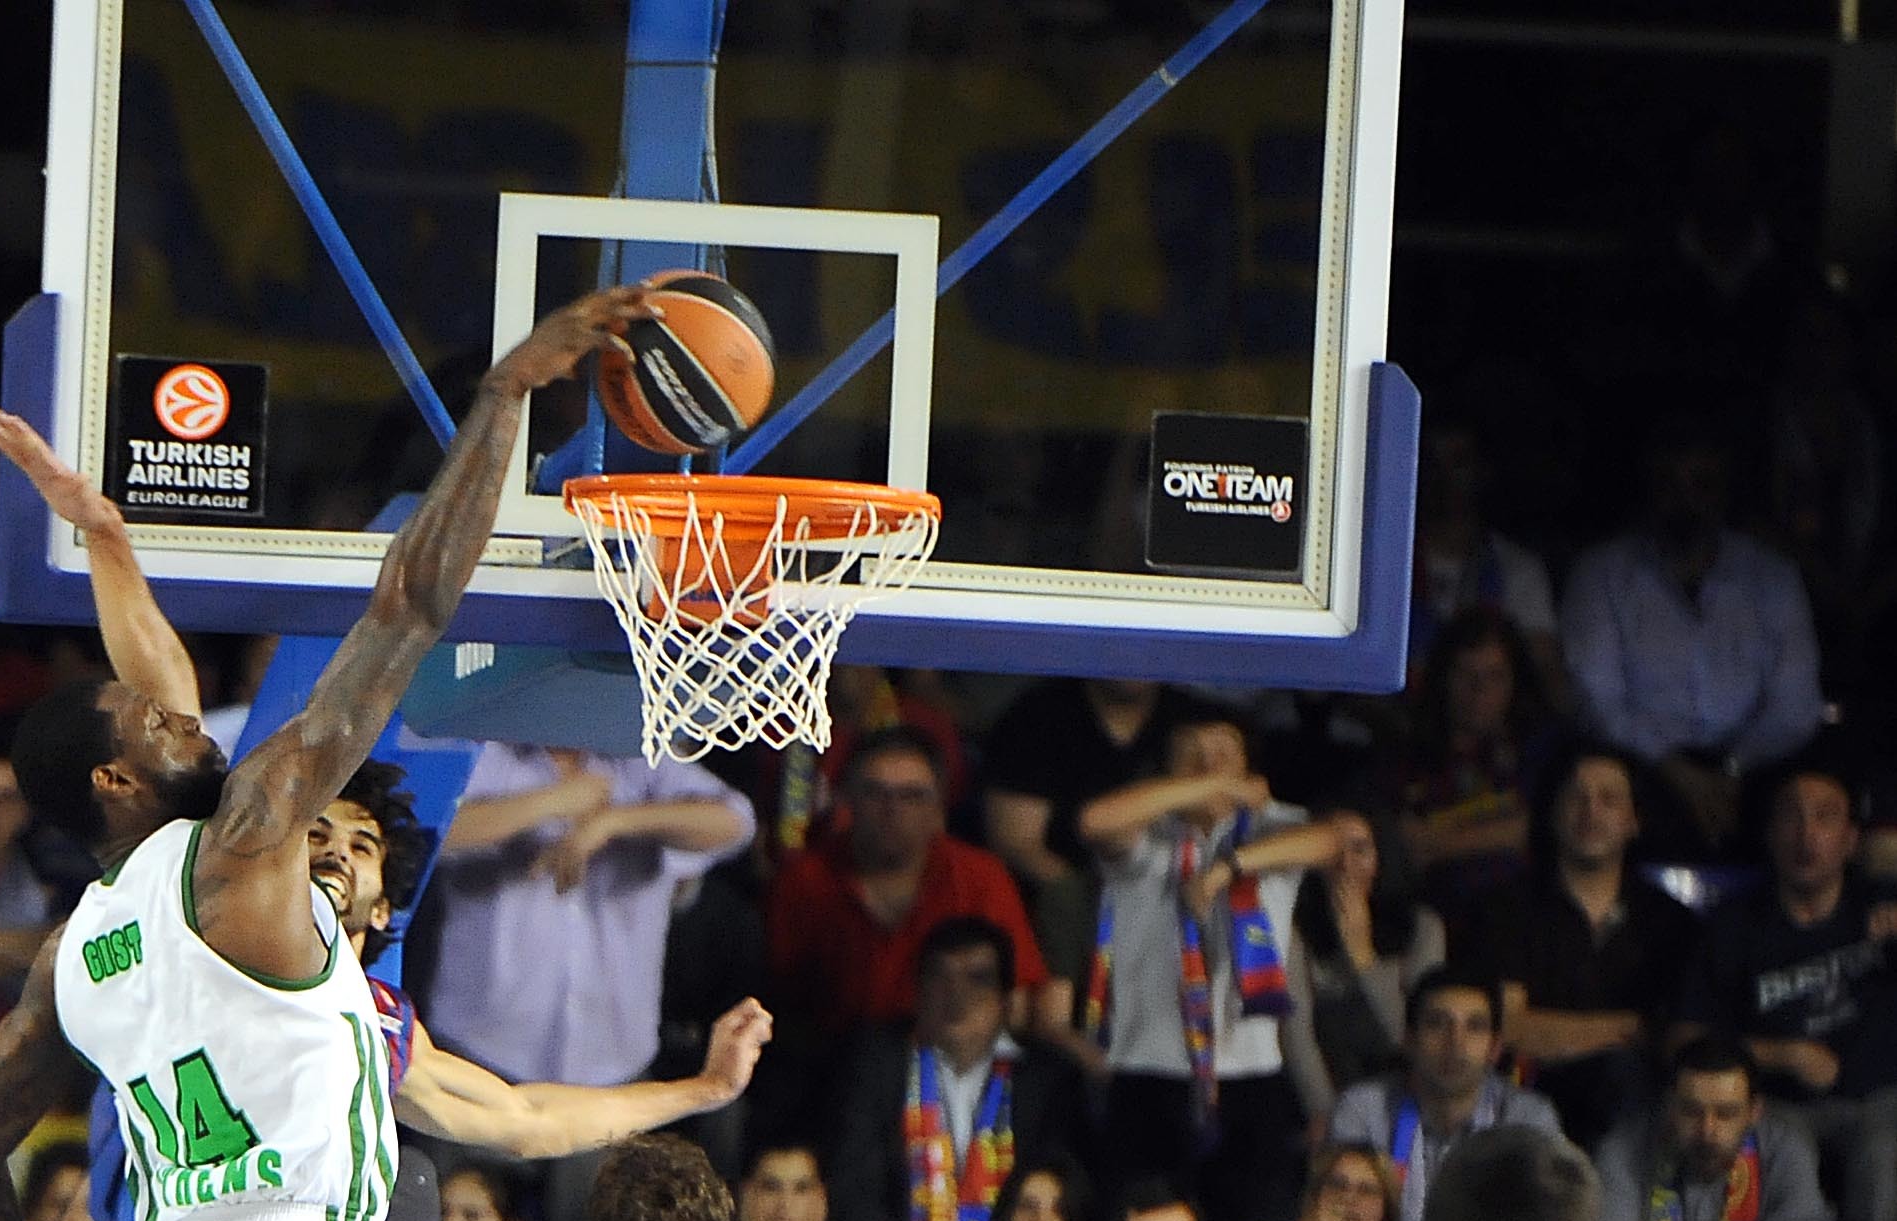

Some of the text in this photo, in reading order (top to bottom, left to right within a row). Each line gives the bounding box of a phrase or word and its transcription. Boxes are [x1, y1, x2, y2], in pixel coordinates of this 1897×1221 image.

[129, 440, 250, 467] TURKISH
[127, 463, 250, 490] AIRLINES
[127, 491, 249, 510] EUROLEAGUE
[82, 920, 143, 983] GIST
[126, 1046, 262, 1170] 14
